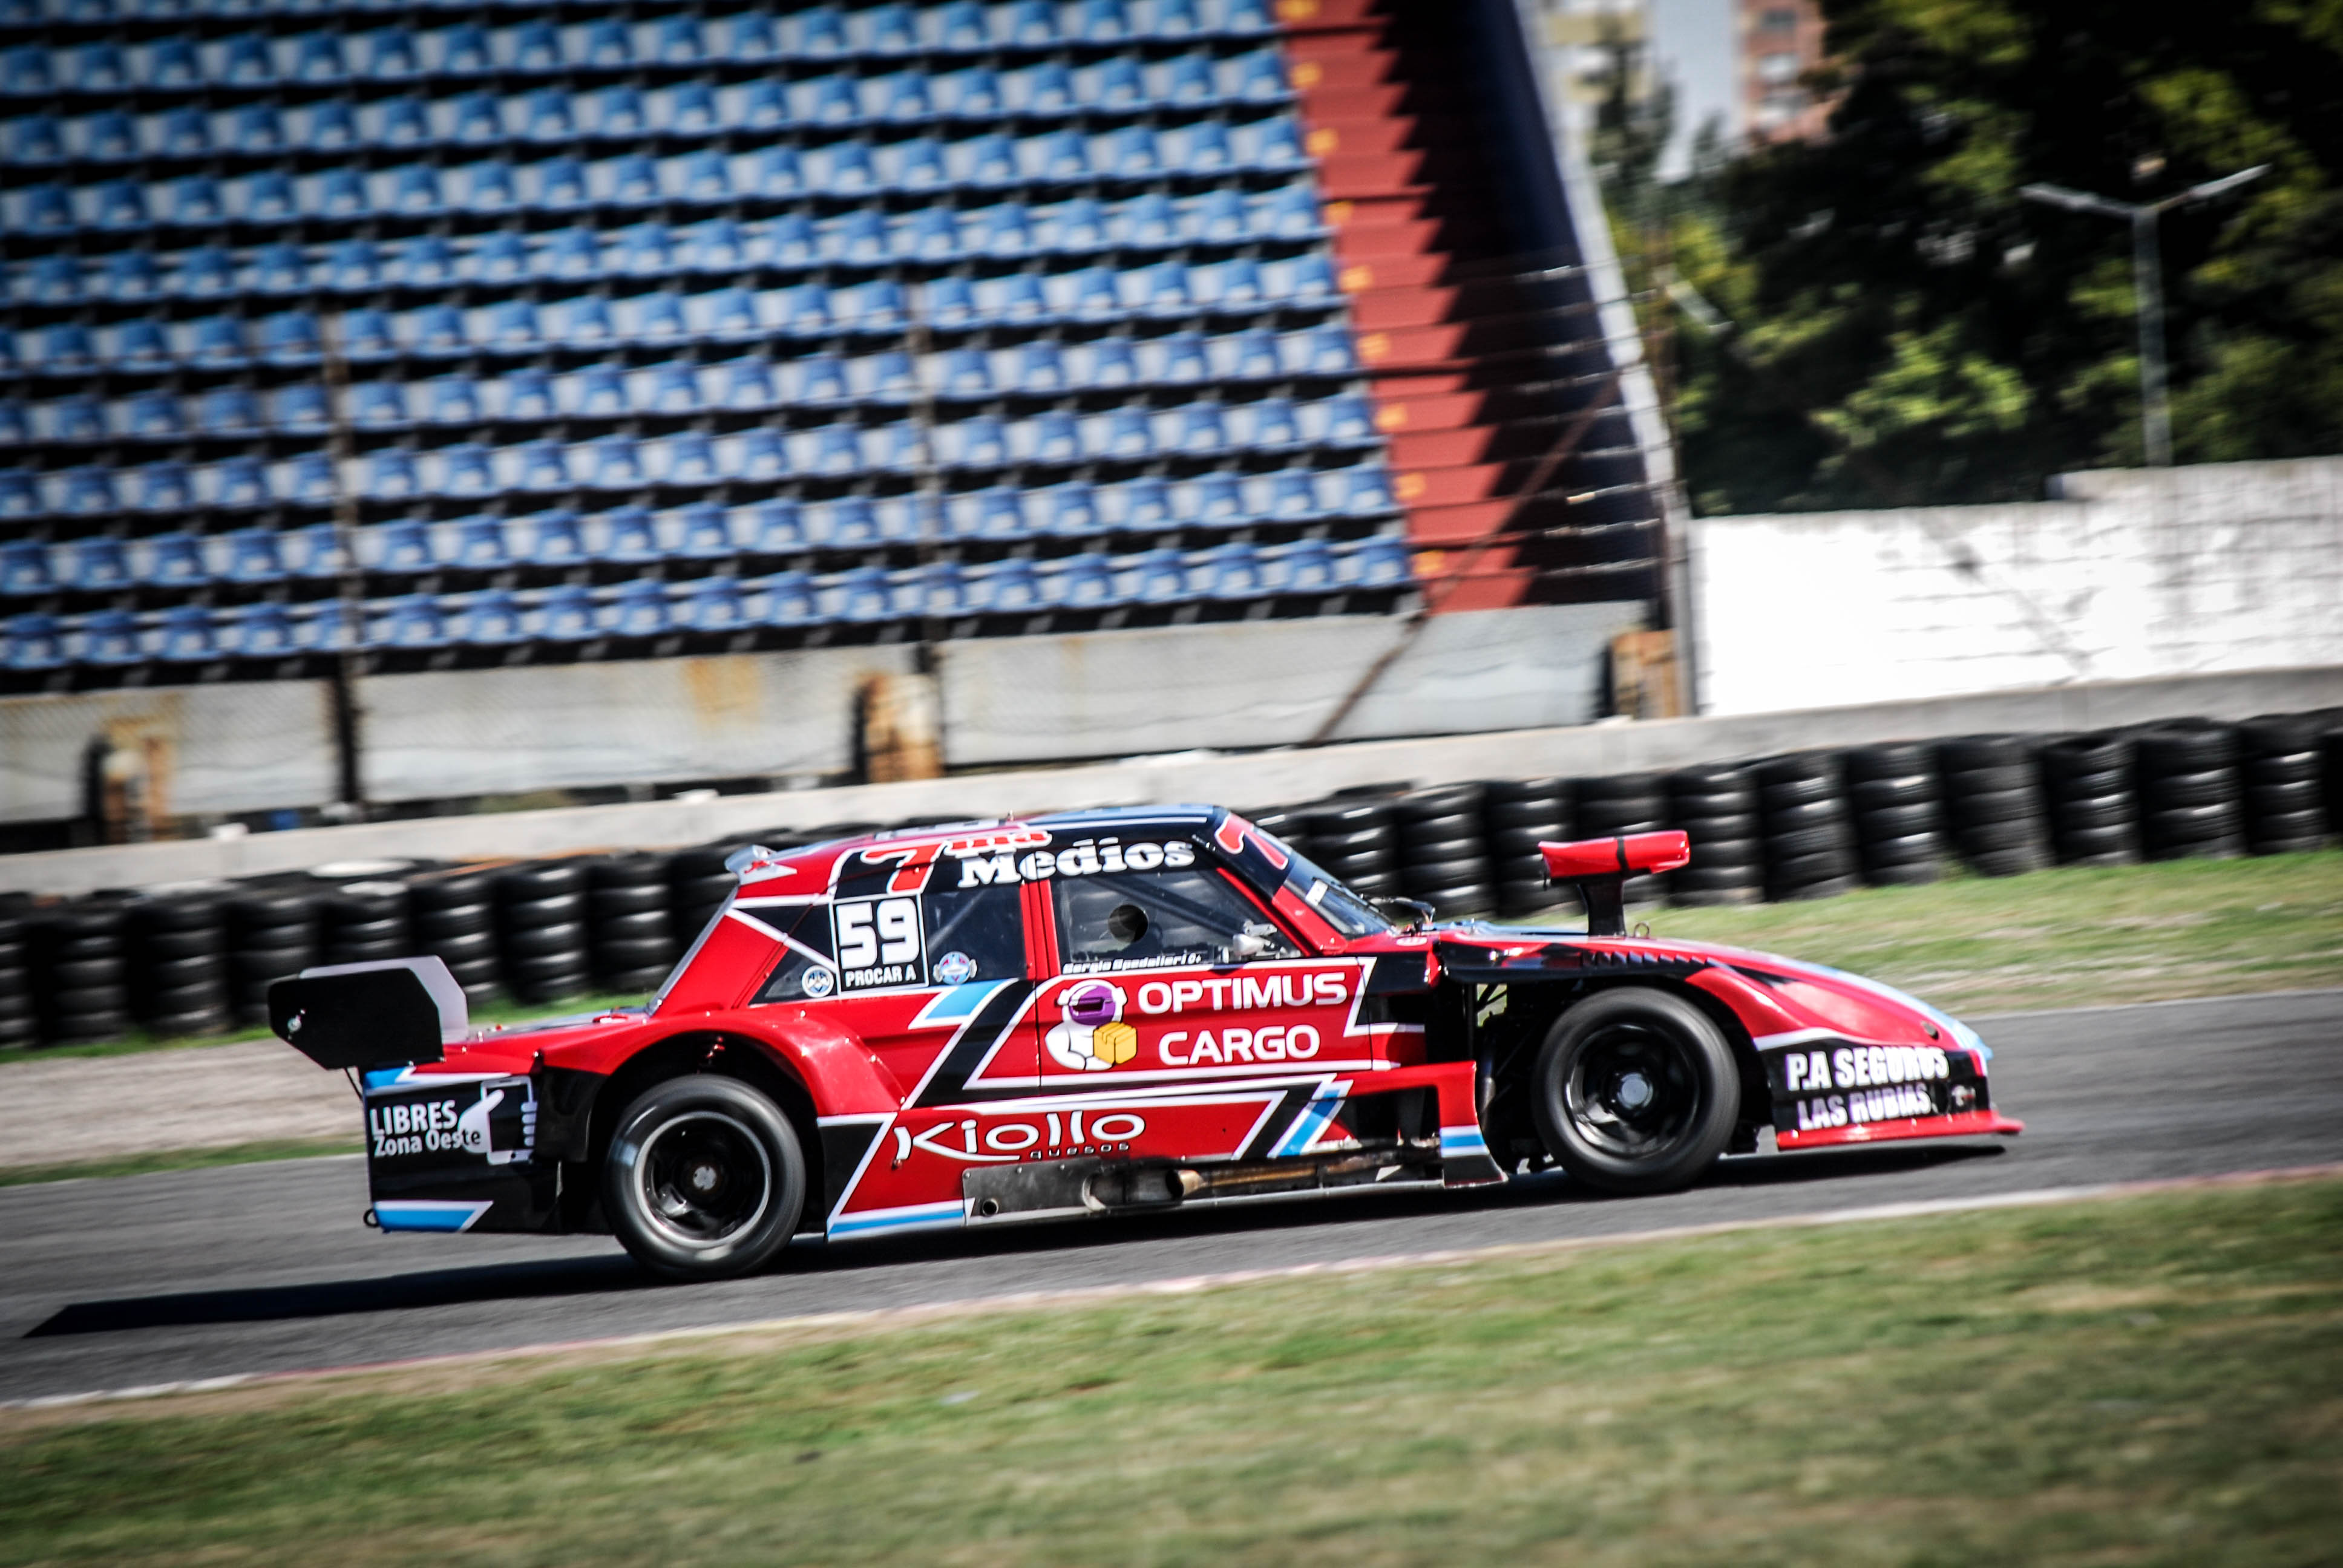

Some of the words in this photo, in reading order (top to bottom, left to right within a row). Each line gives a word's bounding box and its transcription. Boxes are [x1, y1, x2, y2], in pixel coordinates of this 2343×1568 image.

[957, 837, 1195, 887] Medios
[836, 898, 920, 969] 59
[845, 965, 903, 987] PROCAR
[906, 964, 916, 980] A
[1062, 960, 1112, 975] Sergio
[1138, 972, 1348, 1014] OPTIMUS
[1159, 1025, 1320, 1065] CARGO
[1786, 1051, 1832, 1091] P.A
[1834, 1045, 1950, 1088] SEGUROS
[370, 1100, 457, 1136] LIBRES
[1797, 1095, 1848, 1131] LAS
[1849, 1082, 1932, 1123] RUBIAS
[373, 1134, 422, 1157] Zona
[425, 1128, 482, 1151] Oeste
[893, 1110, 1145, 1161] Kiollo
[1029, 1141, 1130, 1160] quesos
